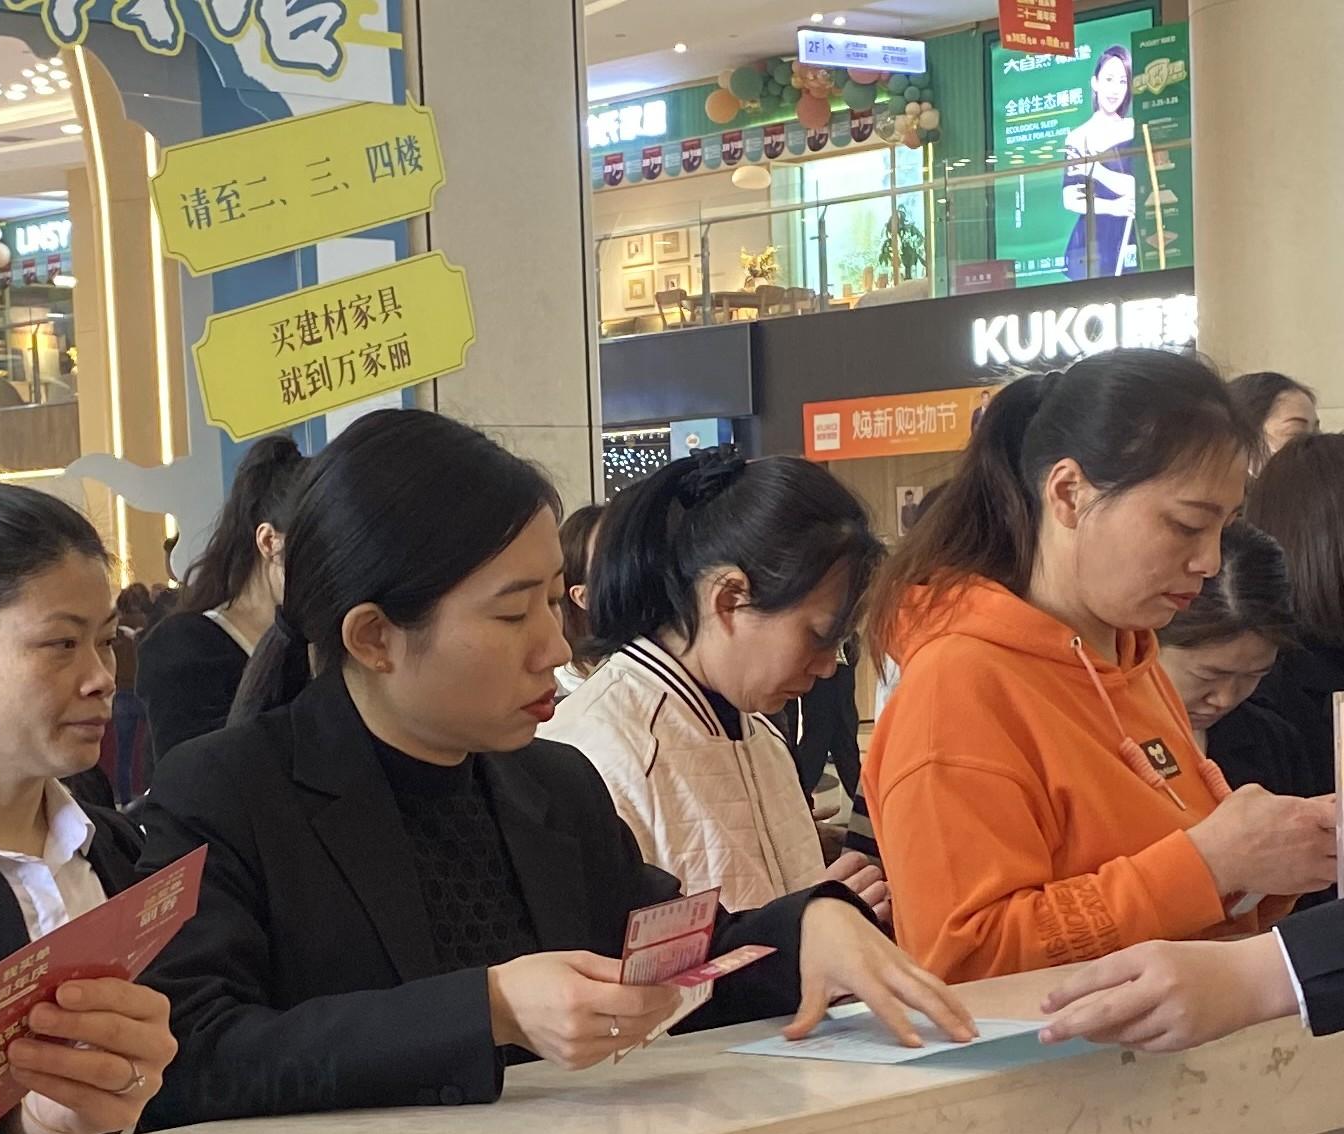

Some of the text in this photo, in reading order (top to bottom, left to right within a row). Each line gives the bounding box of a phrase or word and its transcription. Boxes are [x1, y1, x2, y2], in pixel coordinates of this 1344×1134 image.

[808, 41, 820, 53] 2F
[269, 286, 402, 357] 买建材家具
[279, 333, 412, 405] 就到万家丽
[851, 402, 958, 440] 焕新购物节
